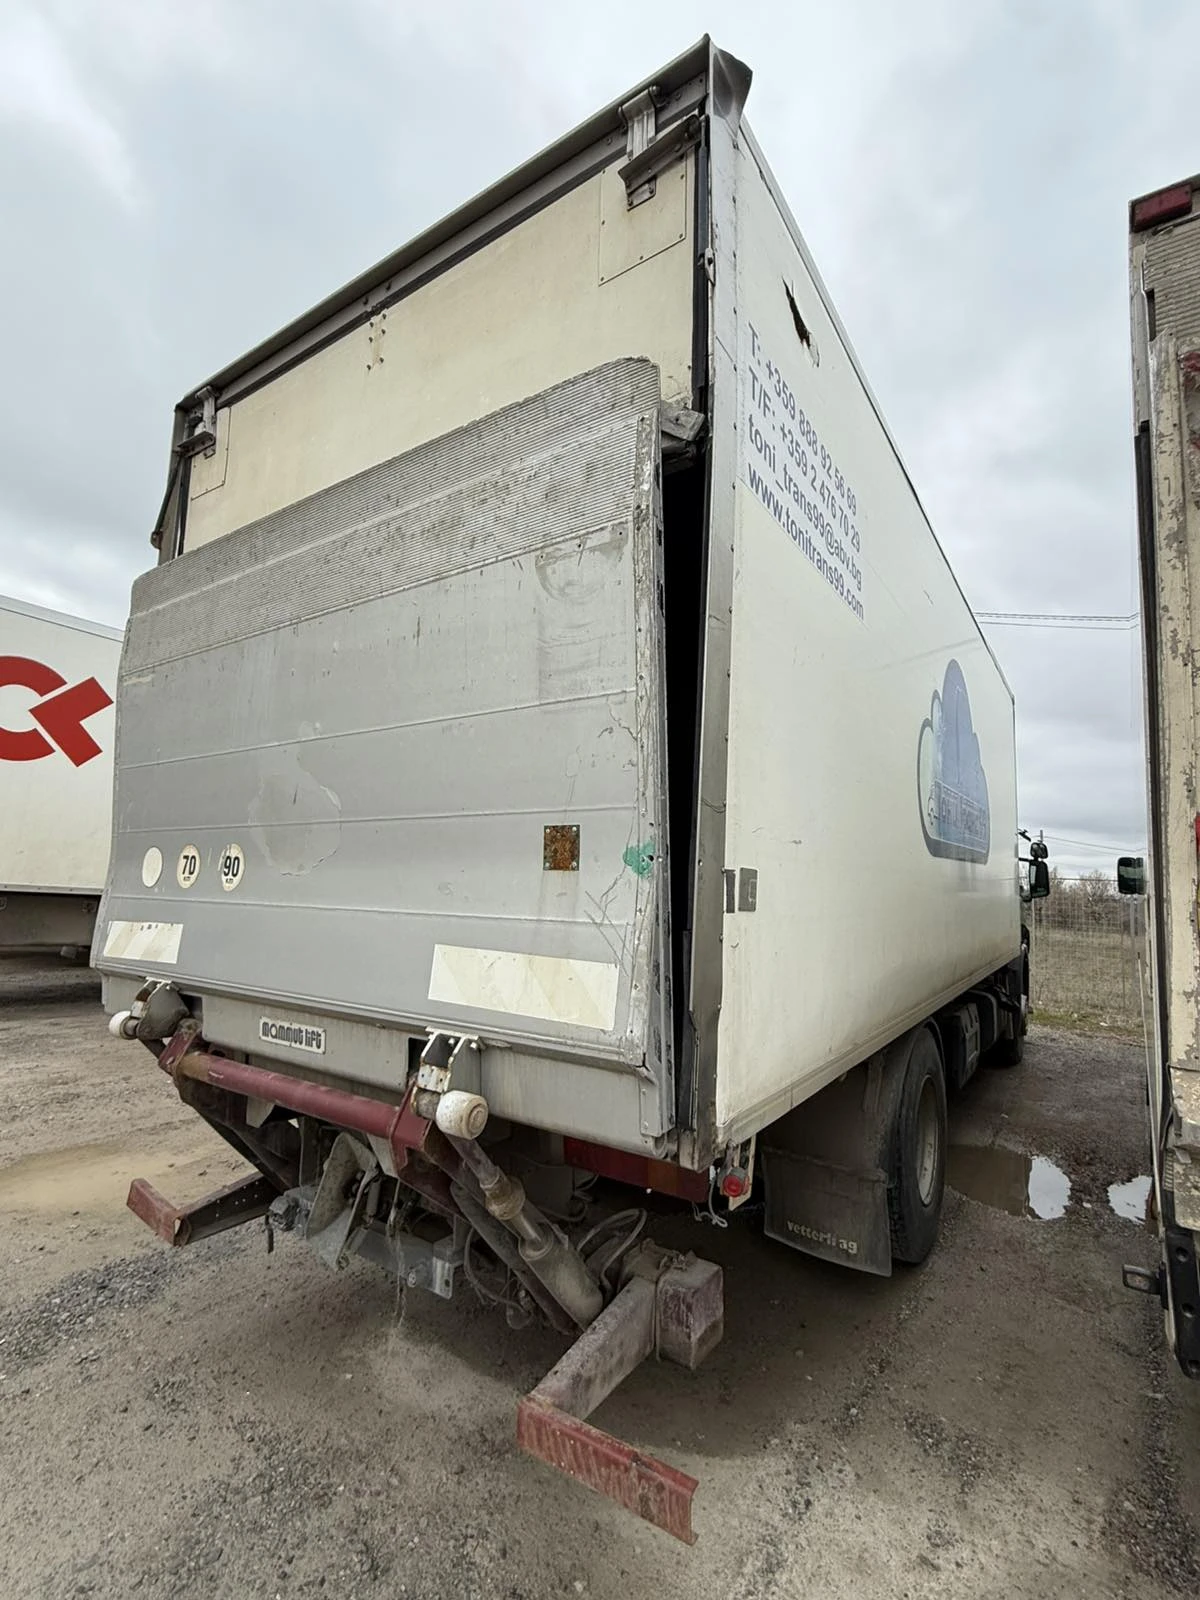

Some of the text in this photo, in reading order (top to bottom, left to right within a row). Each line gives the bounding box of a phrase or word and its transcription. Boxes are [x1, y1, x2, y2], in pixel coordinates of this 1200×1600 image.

[748, 321, 761, 366] T:
[766, 360, 796, 420] +359
[799, 409, 818, 456] 888
[820, 444, 833, 480] 92
[834, 467, 845, 499] 56
[748, 365, 861, 553] T/F: +359 2 476 70 29
[748, 463, 864, 620] www.tonitrans99.com
[182, 854, 197, 876] 70
[223, 855, 240, 878] 90
[262, 1021, 322, 1049] mammut lift
[839, 1238, 858, 1255] ag
